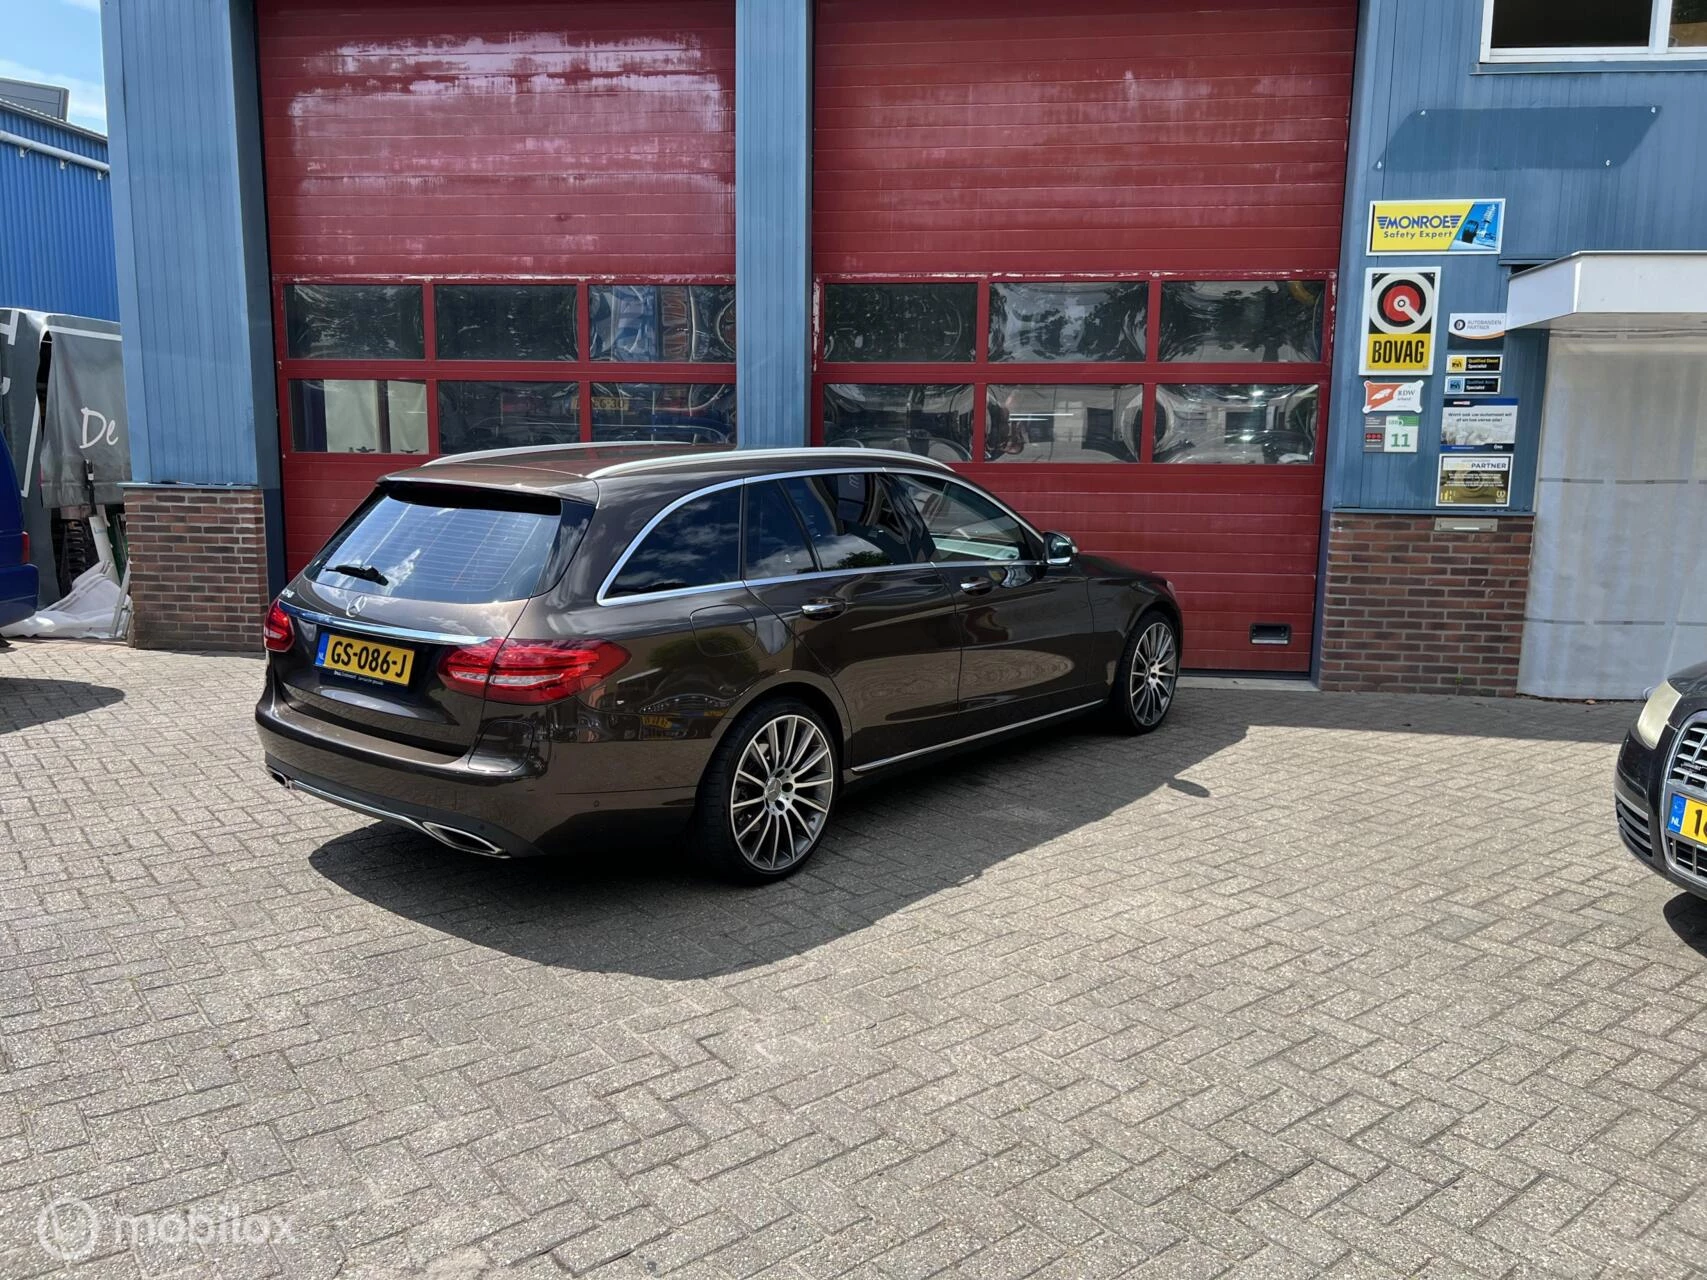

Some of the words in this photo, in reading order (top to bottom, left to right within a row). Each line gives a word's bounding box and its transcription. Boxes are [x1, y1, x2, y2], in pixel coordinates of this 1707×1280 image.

[1386, 215, 1453, 229] MONROE
[1383, 231, 1416, 240] Safety
[1419, 230, 1453, 239] Expert
[1372, 339, 1425, 364] BOVAG
[79, 406, 119, 449] De
[1390, 433, 1411, 448] 11
[331, 641, 407, 678] GS-086-J
